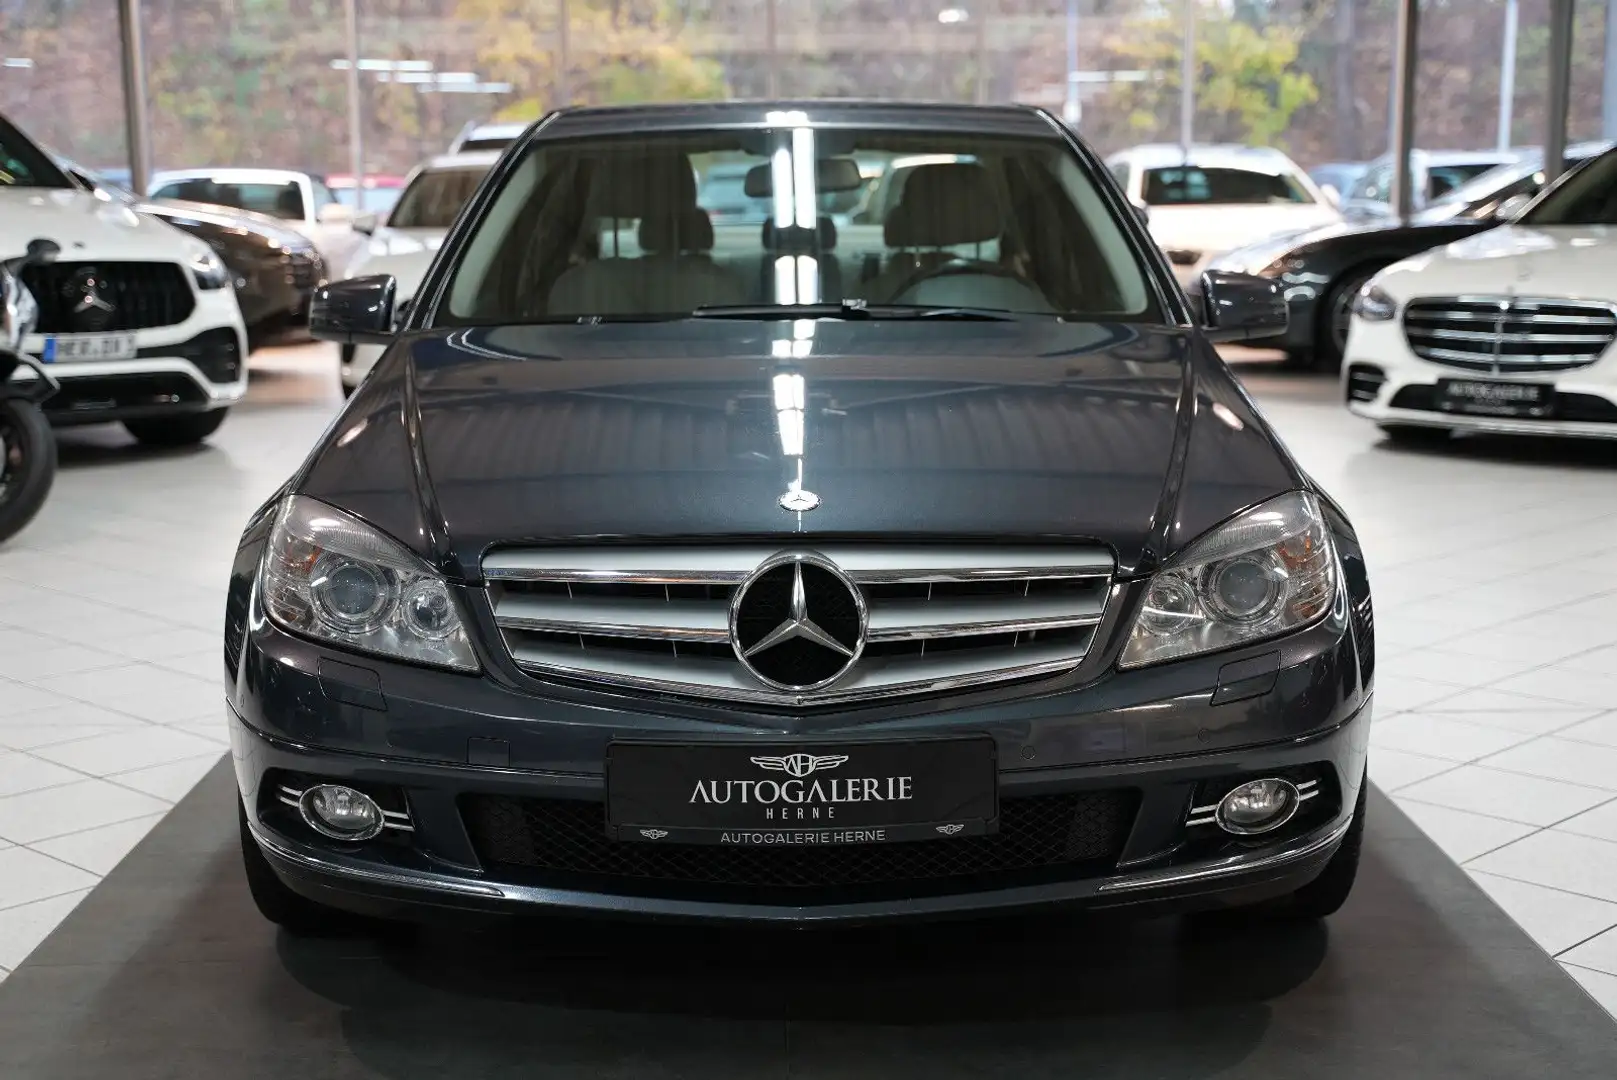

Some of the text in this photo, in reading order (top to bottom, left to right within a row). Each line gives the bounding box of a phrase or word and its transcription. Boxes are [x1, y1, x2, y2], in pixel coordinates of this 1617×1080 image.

[689, 776, 912, 804] AUTOGALERIE
[766, 806, 835, 820] HERNE
[720, 829, 886, 844] AUTOGALERIE HERNE
